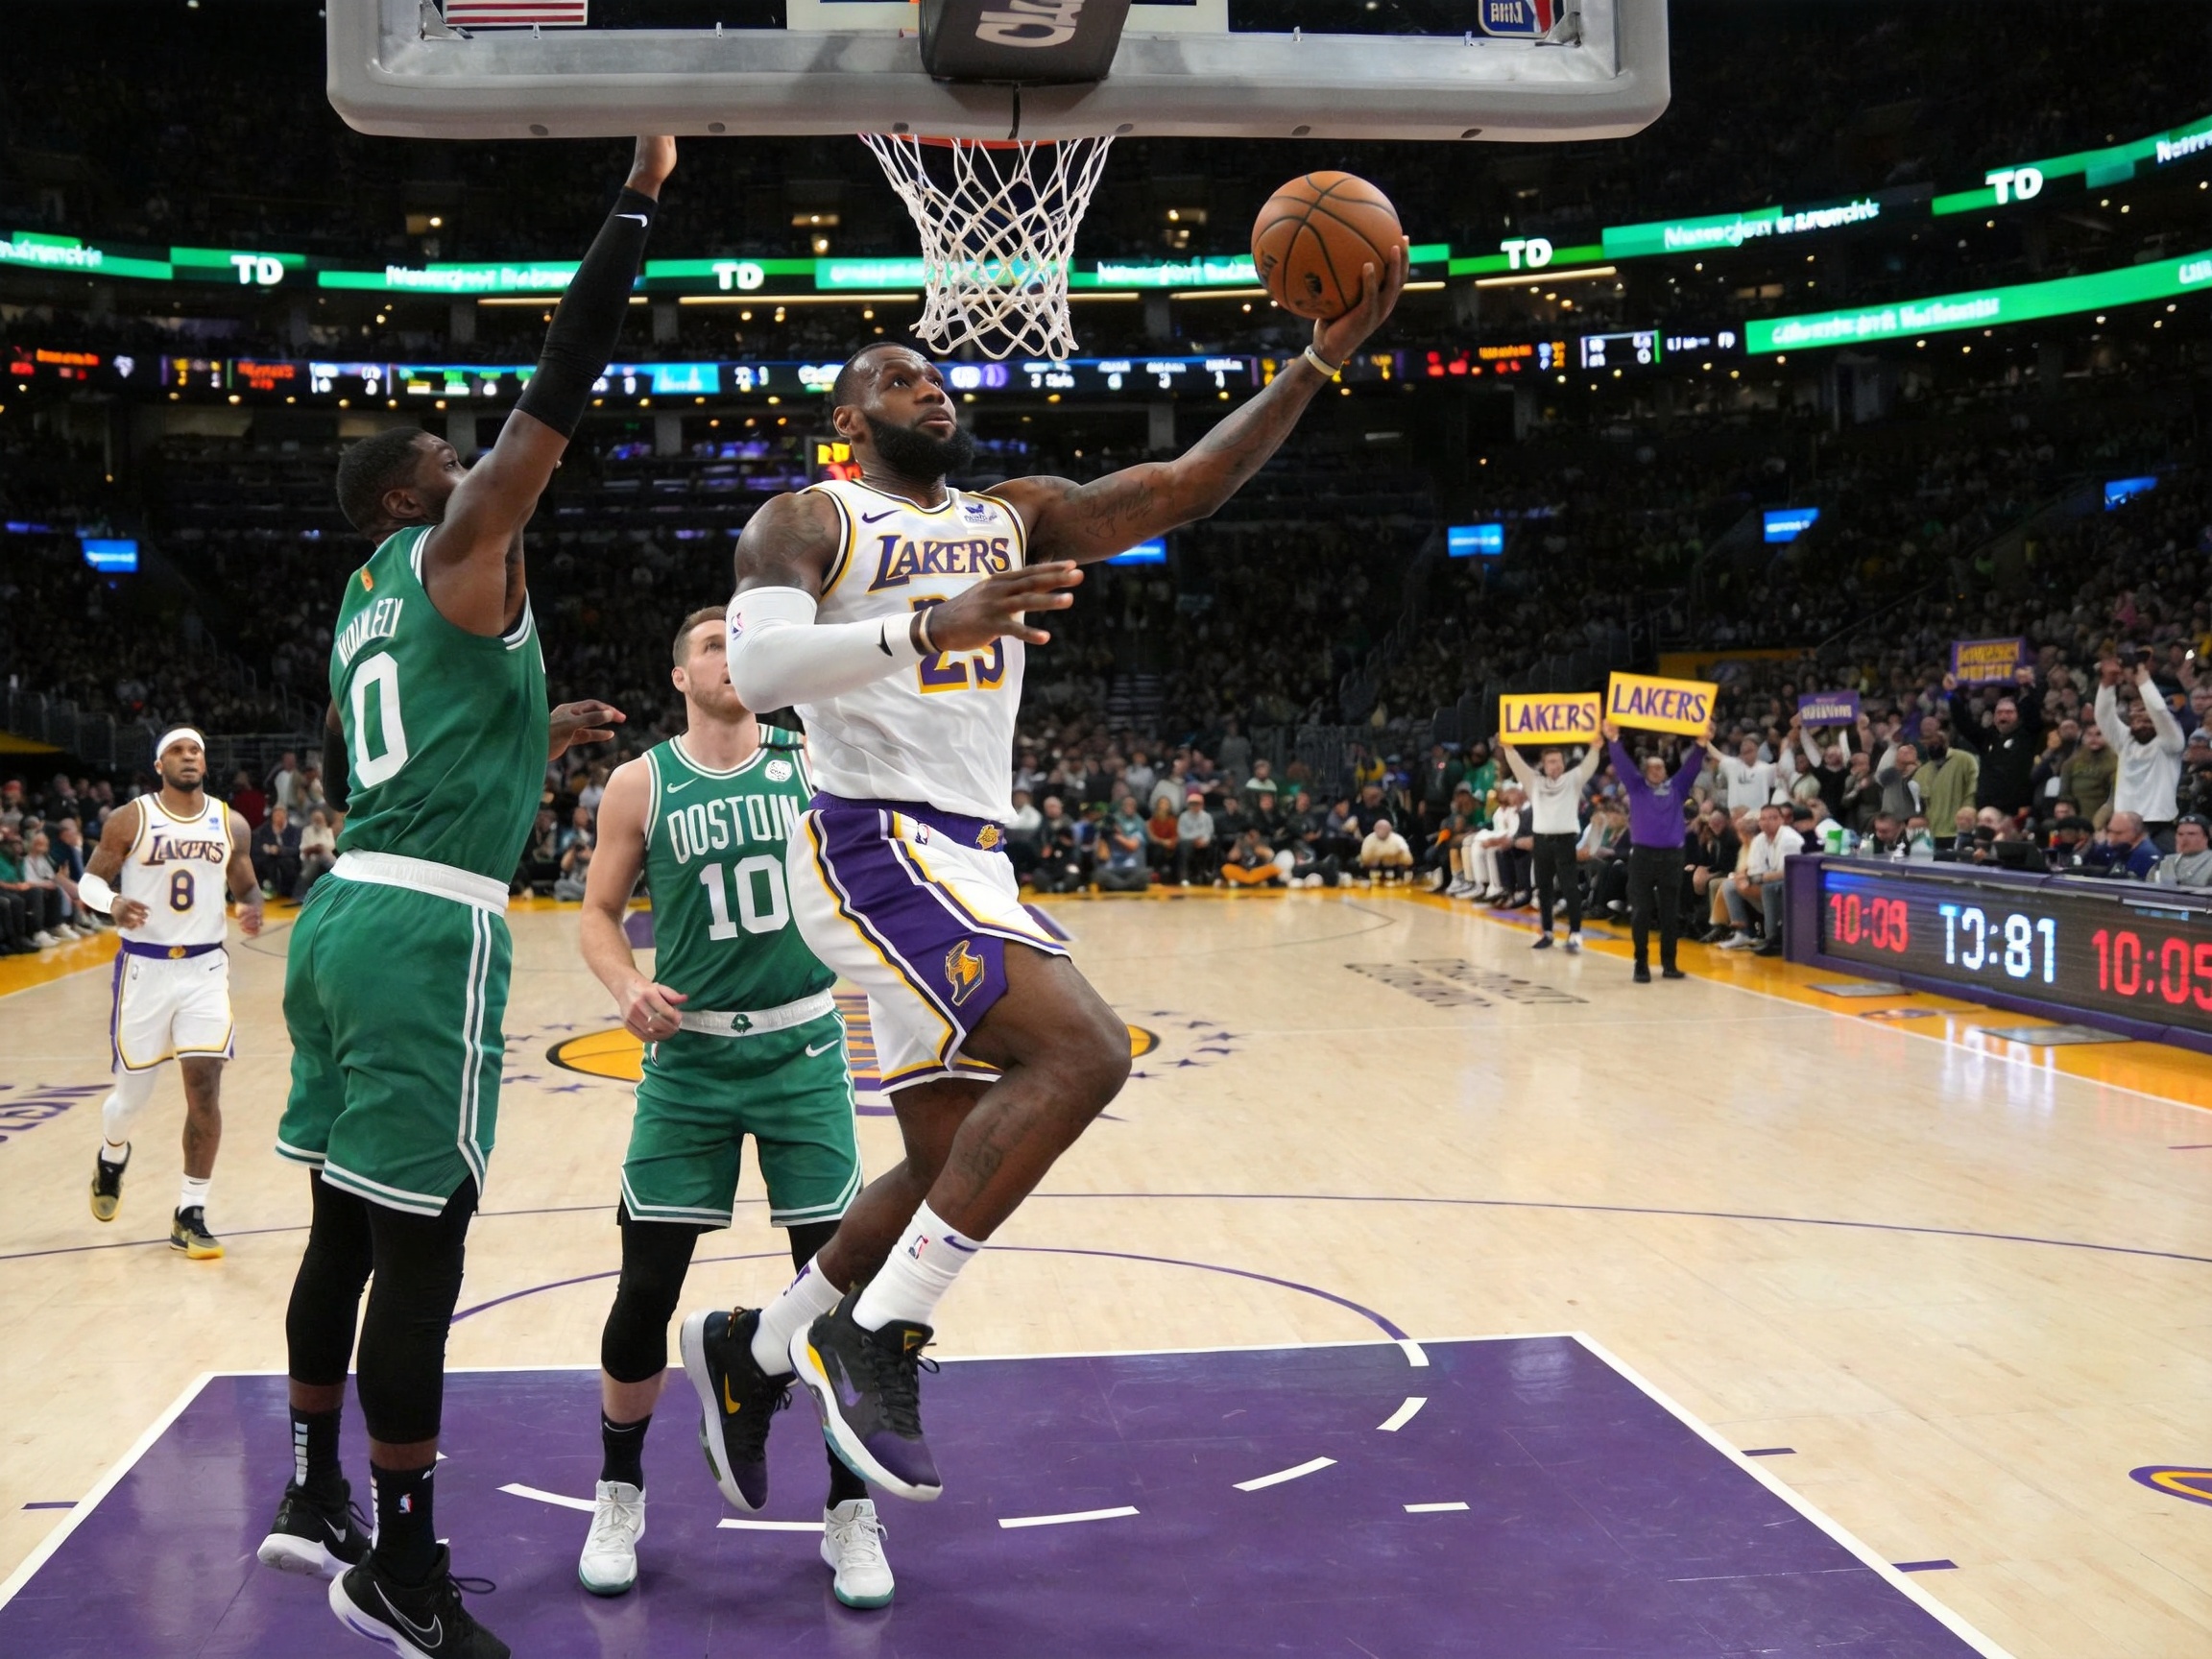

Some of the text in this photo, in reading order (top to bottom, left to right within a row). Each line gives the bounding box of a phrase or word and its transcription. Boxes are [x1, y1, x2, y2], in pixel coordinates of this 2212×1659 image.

[1985, 168, 2045, 204] TD
[230, 254, 285, 286] TD
[1500, 237, 1553, 270] TD
[712, 262, 764, 290] TD
[866, 534, 1011, 594] LAKERS
[350, 650, 409, 789] 0
[1504, 702, 1596, 733] LAKERS
[1611, 683, 1707, 724] LAKERS
[169, 868, 195, 913] 8
[698, 854, 790, 941] 10
[2091, 928, 2212, 1013] 10:05
